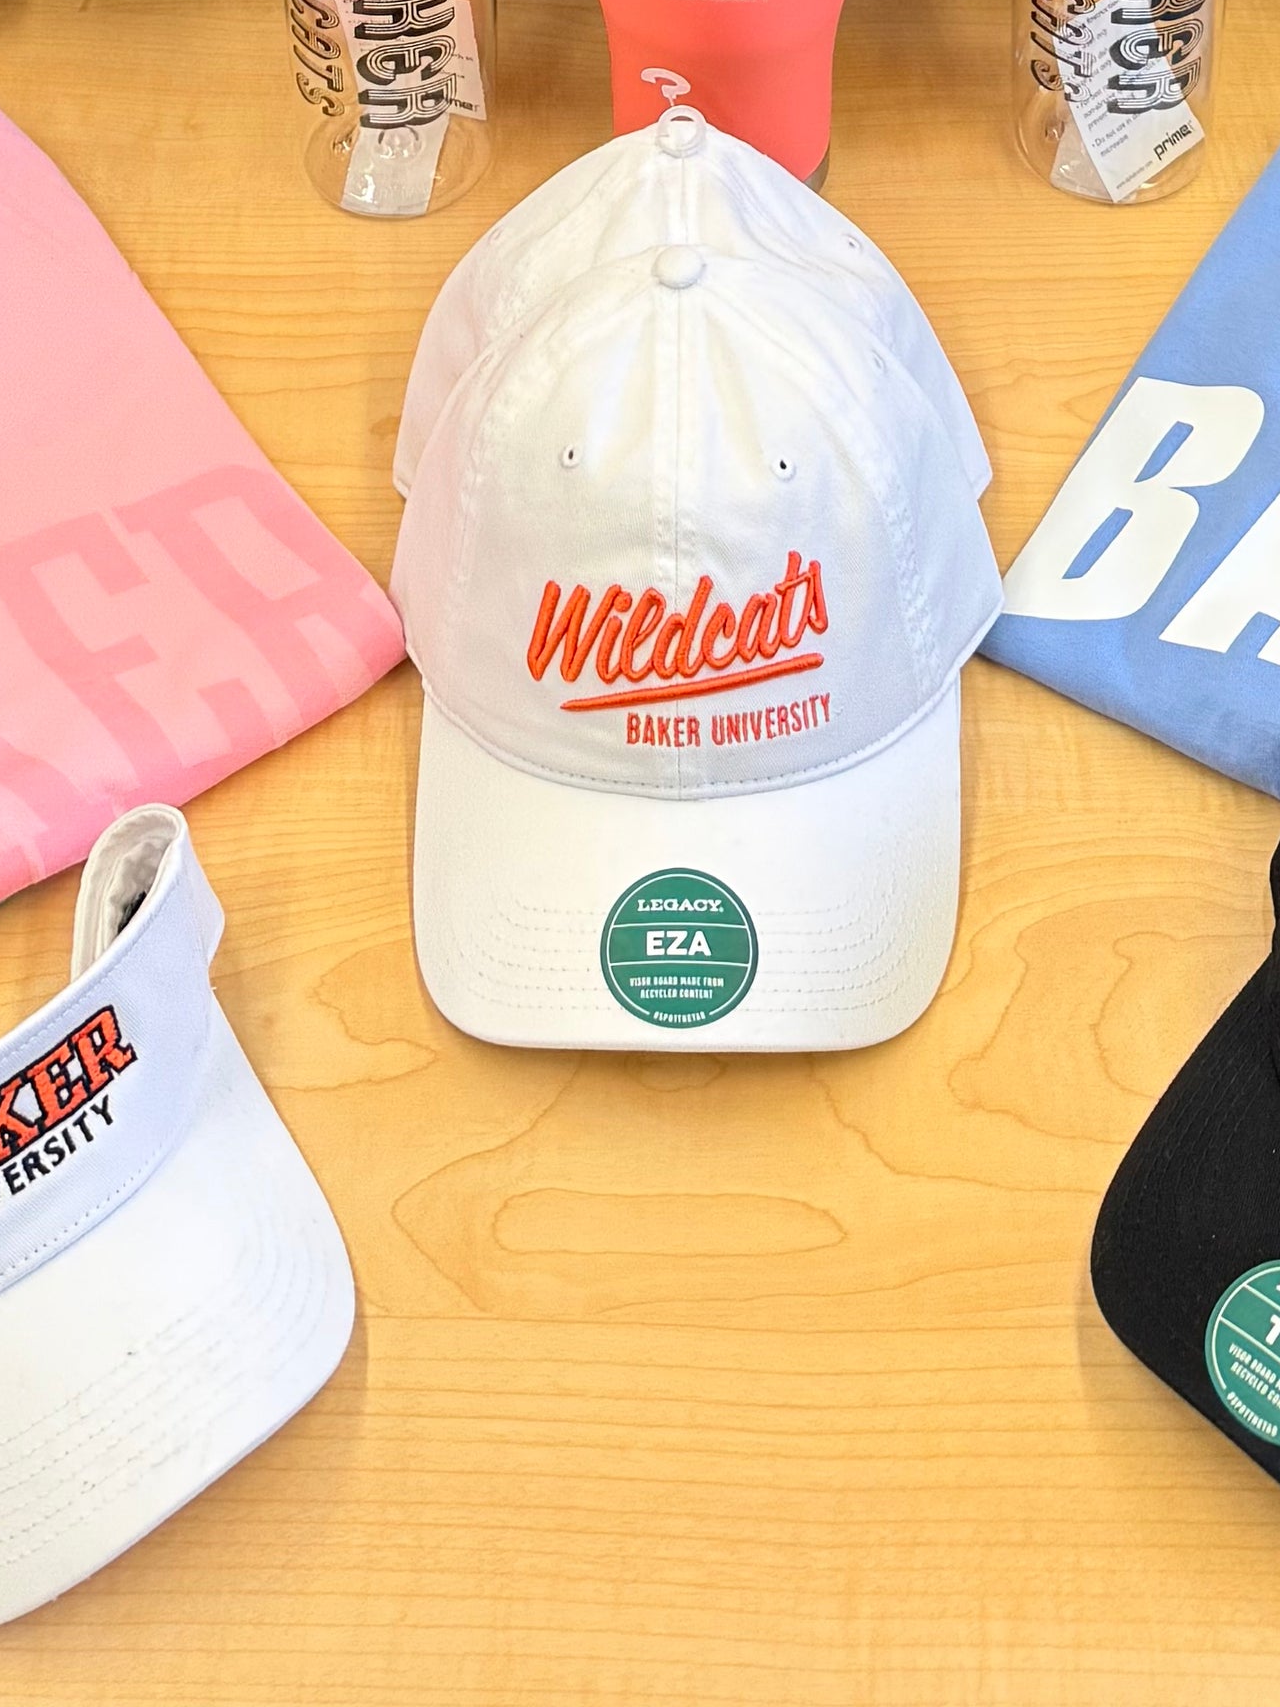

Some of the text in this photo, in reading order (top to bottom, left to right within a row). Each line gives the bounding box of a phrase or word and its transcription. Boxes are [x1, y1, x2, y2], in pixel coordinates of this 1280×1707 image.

[526, 550, 829, 684] Wildcats
[626, 692, 831, 748] BAKER UNIVERSITY
[636, 898, 723, 913] LEGACY
[646, 930, 712, 957] EZA
[629, 975, 725, 988] VISOR BOARD MADE FROM
[640, 988, 714, 1000] RECYCLED CONTENT
[1228, 1342, 1253, 1366] VISOR
[1250, 1357, 1276, 1384] BOARD
[1230, 1361, 1268, 1396] RECYCLED
